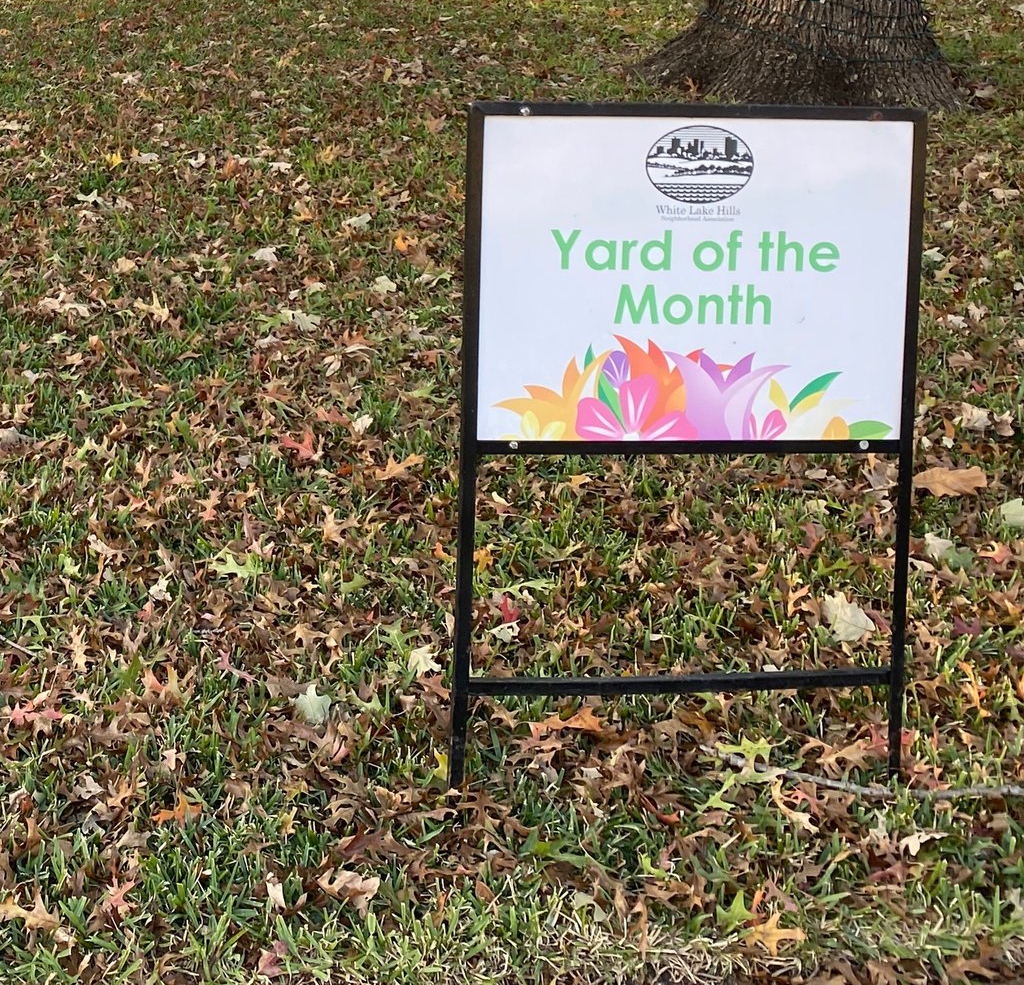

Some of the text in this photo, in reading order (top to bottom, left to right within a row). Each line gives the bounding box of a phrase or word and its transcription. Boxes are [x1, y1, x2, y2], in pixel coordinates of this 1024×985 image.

[656, 205, 741, 216] White Lake Hills
[551, 229, 840, 272] Yard of the
[614, 284, 772, 325] Month
